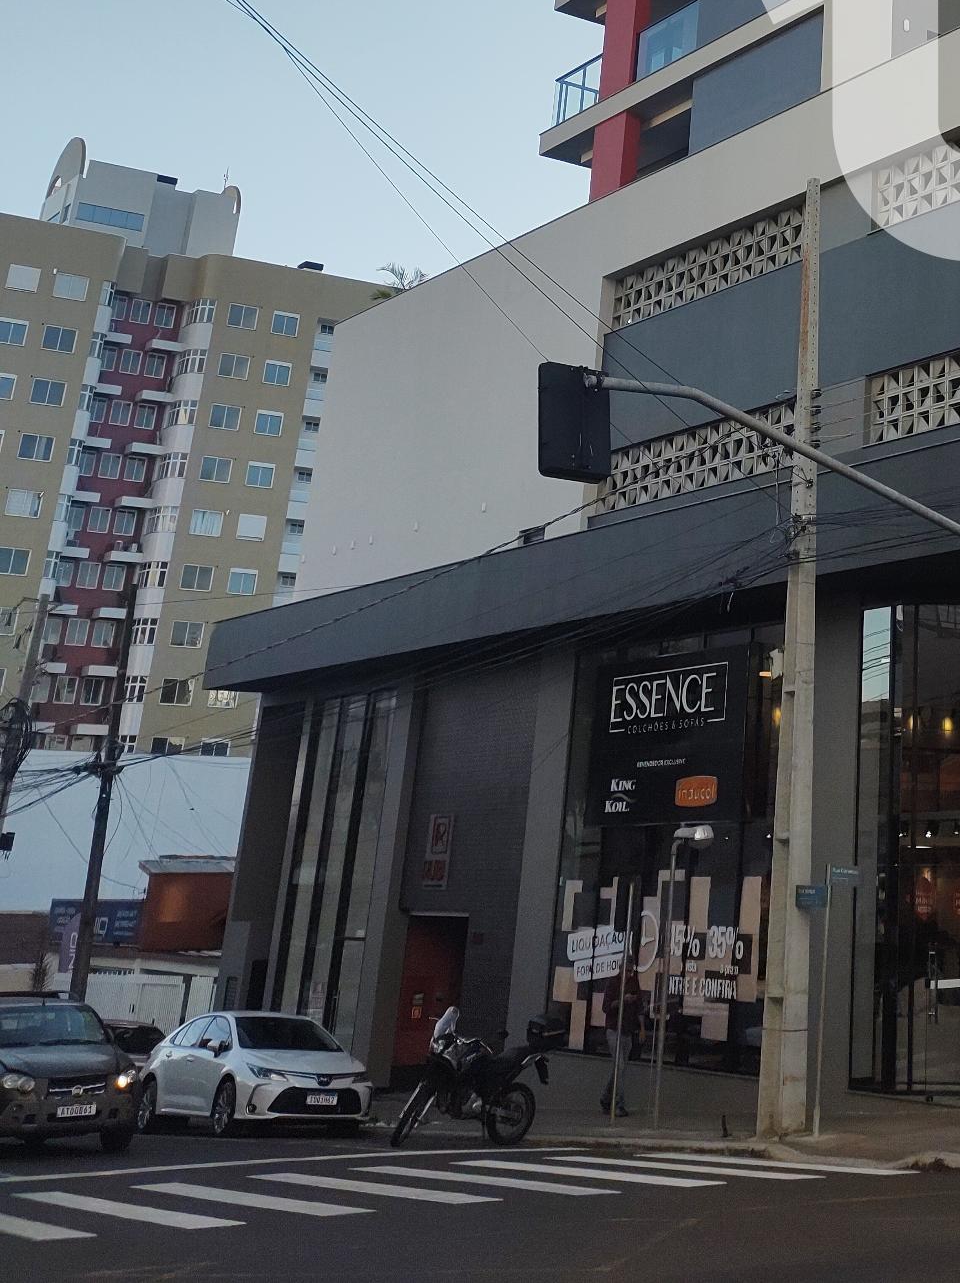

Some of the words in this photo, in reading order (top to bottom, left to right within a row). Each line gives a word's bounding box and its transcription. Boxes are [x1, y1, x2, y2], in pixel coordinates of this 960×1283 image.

[610, 672, 717, 722] ESSENCE
[627, 720, 669, 734] COLCHÕES
[610, 778, 636, 792] KING
